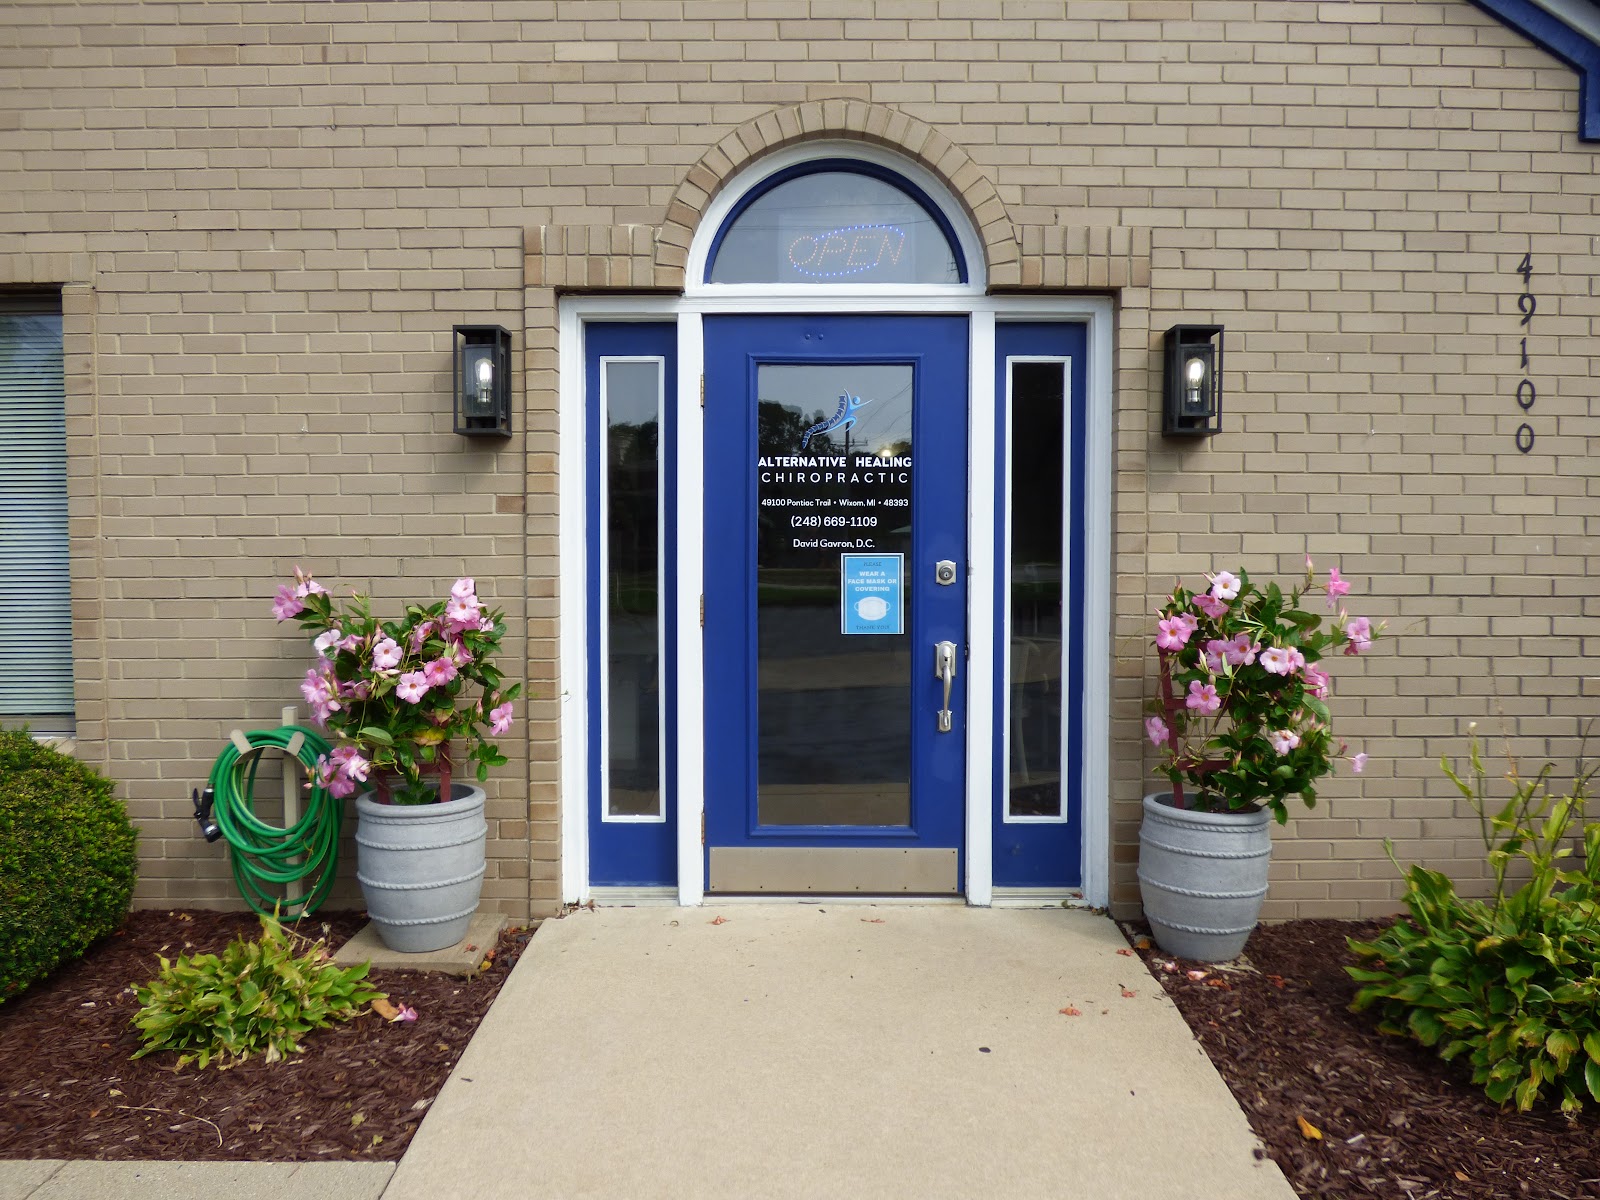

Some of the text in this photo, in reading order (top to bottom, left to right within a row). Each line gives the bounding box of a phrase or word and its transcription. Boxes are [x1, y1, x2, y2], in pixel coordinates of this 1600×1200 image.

[788, 234, 905, 266] OPEN
[1515, 252, 1537, 454] 49100
[758, 456, 912, 468] ALTERNATIVE HEALING
[761, 472, 908, 483] CHIROPRACTIC
[761, 498, 909, 508] 49100 Pontiac Trail Wixom, MI 48393
[790, 515, 878, 528] (248) 669-1109
[793, 538, 875, 549] David Gavron, D.C.
